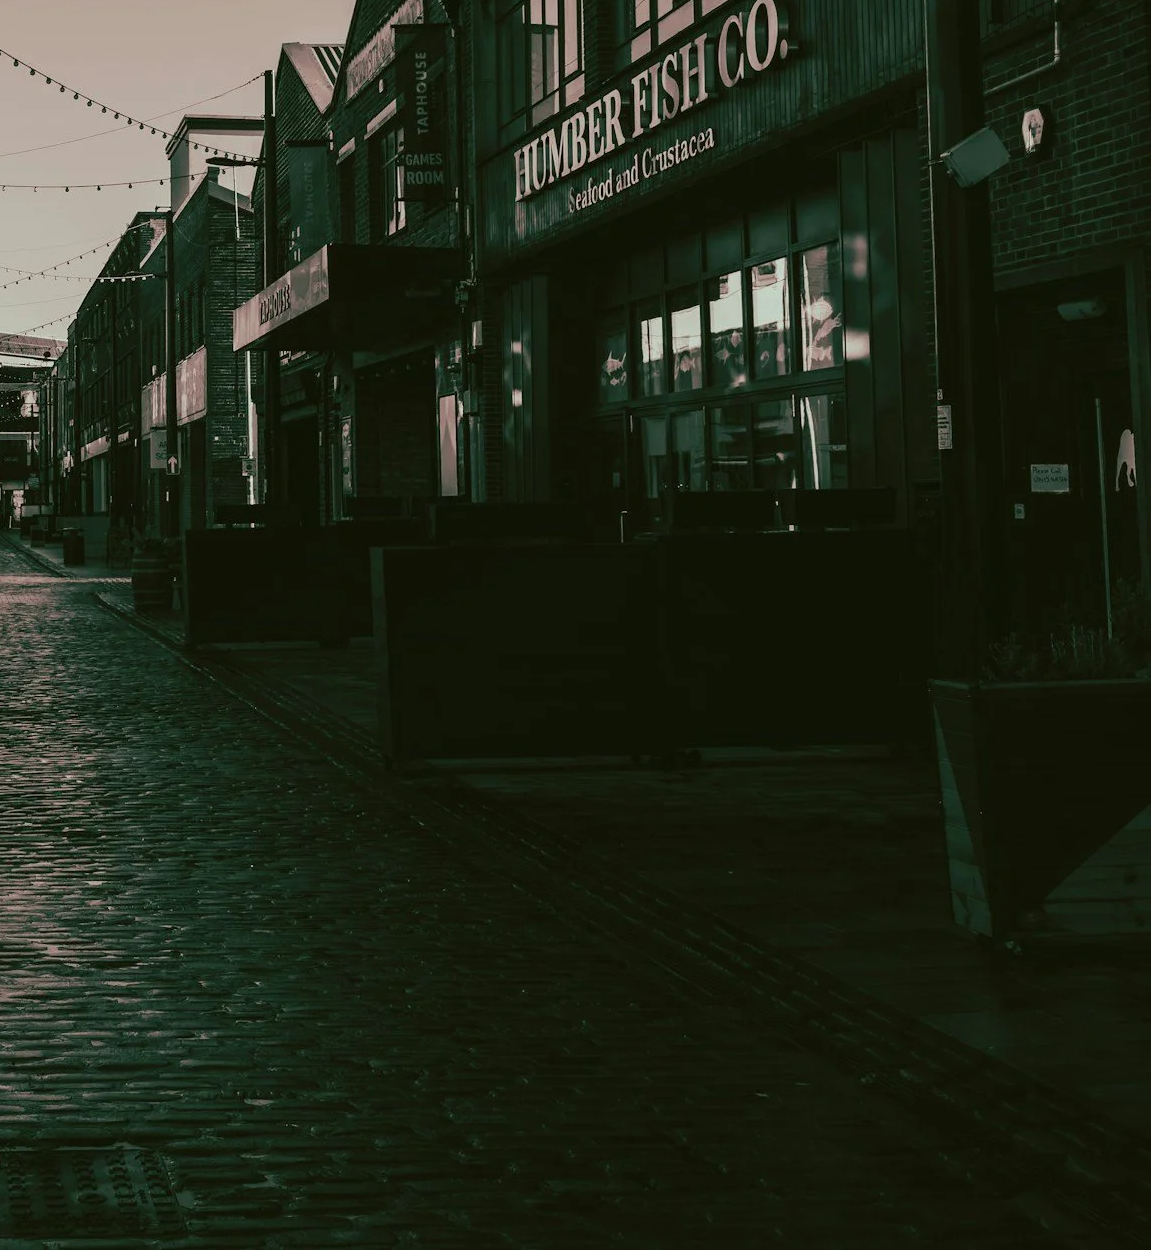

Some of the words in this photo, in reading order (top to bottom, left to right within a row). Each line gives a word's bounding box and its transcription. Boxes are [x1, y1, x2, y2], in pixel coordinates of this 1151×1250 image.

[415, 49, 429, 136] TAPHOUSE
[514, 88, 626, 202] HUMBER
[630, 32, 709, 138] FISH
[405, 152, 443, 166] GAMES
[406, 170, 444, 186] ROOM
[568, 167, 613, 213] Seafood
[615, 154, 639, 194] and
[641, 126, 716, 180] Crustacea
